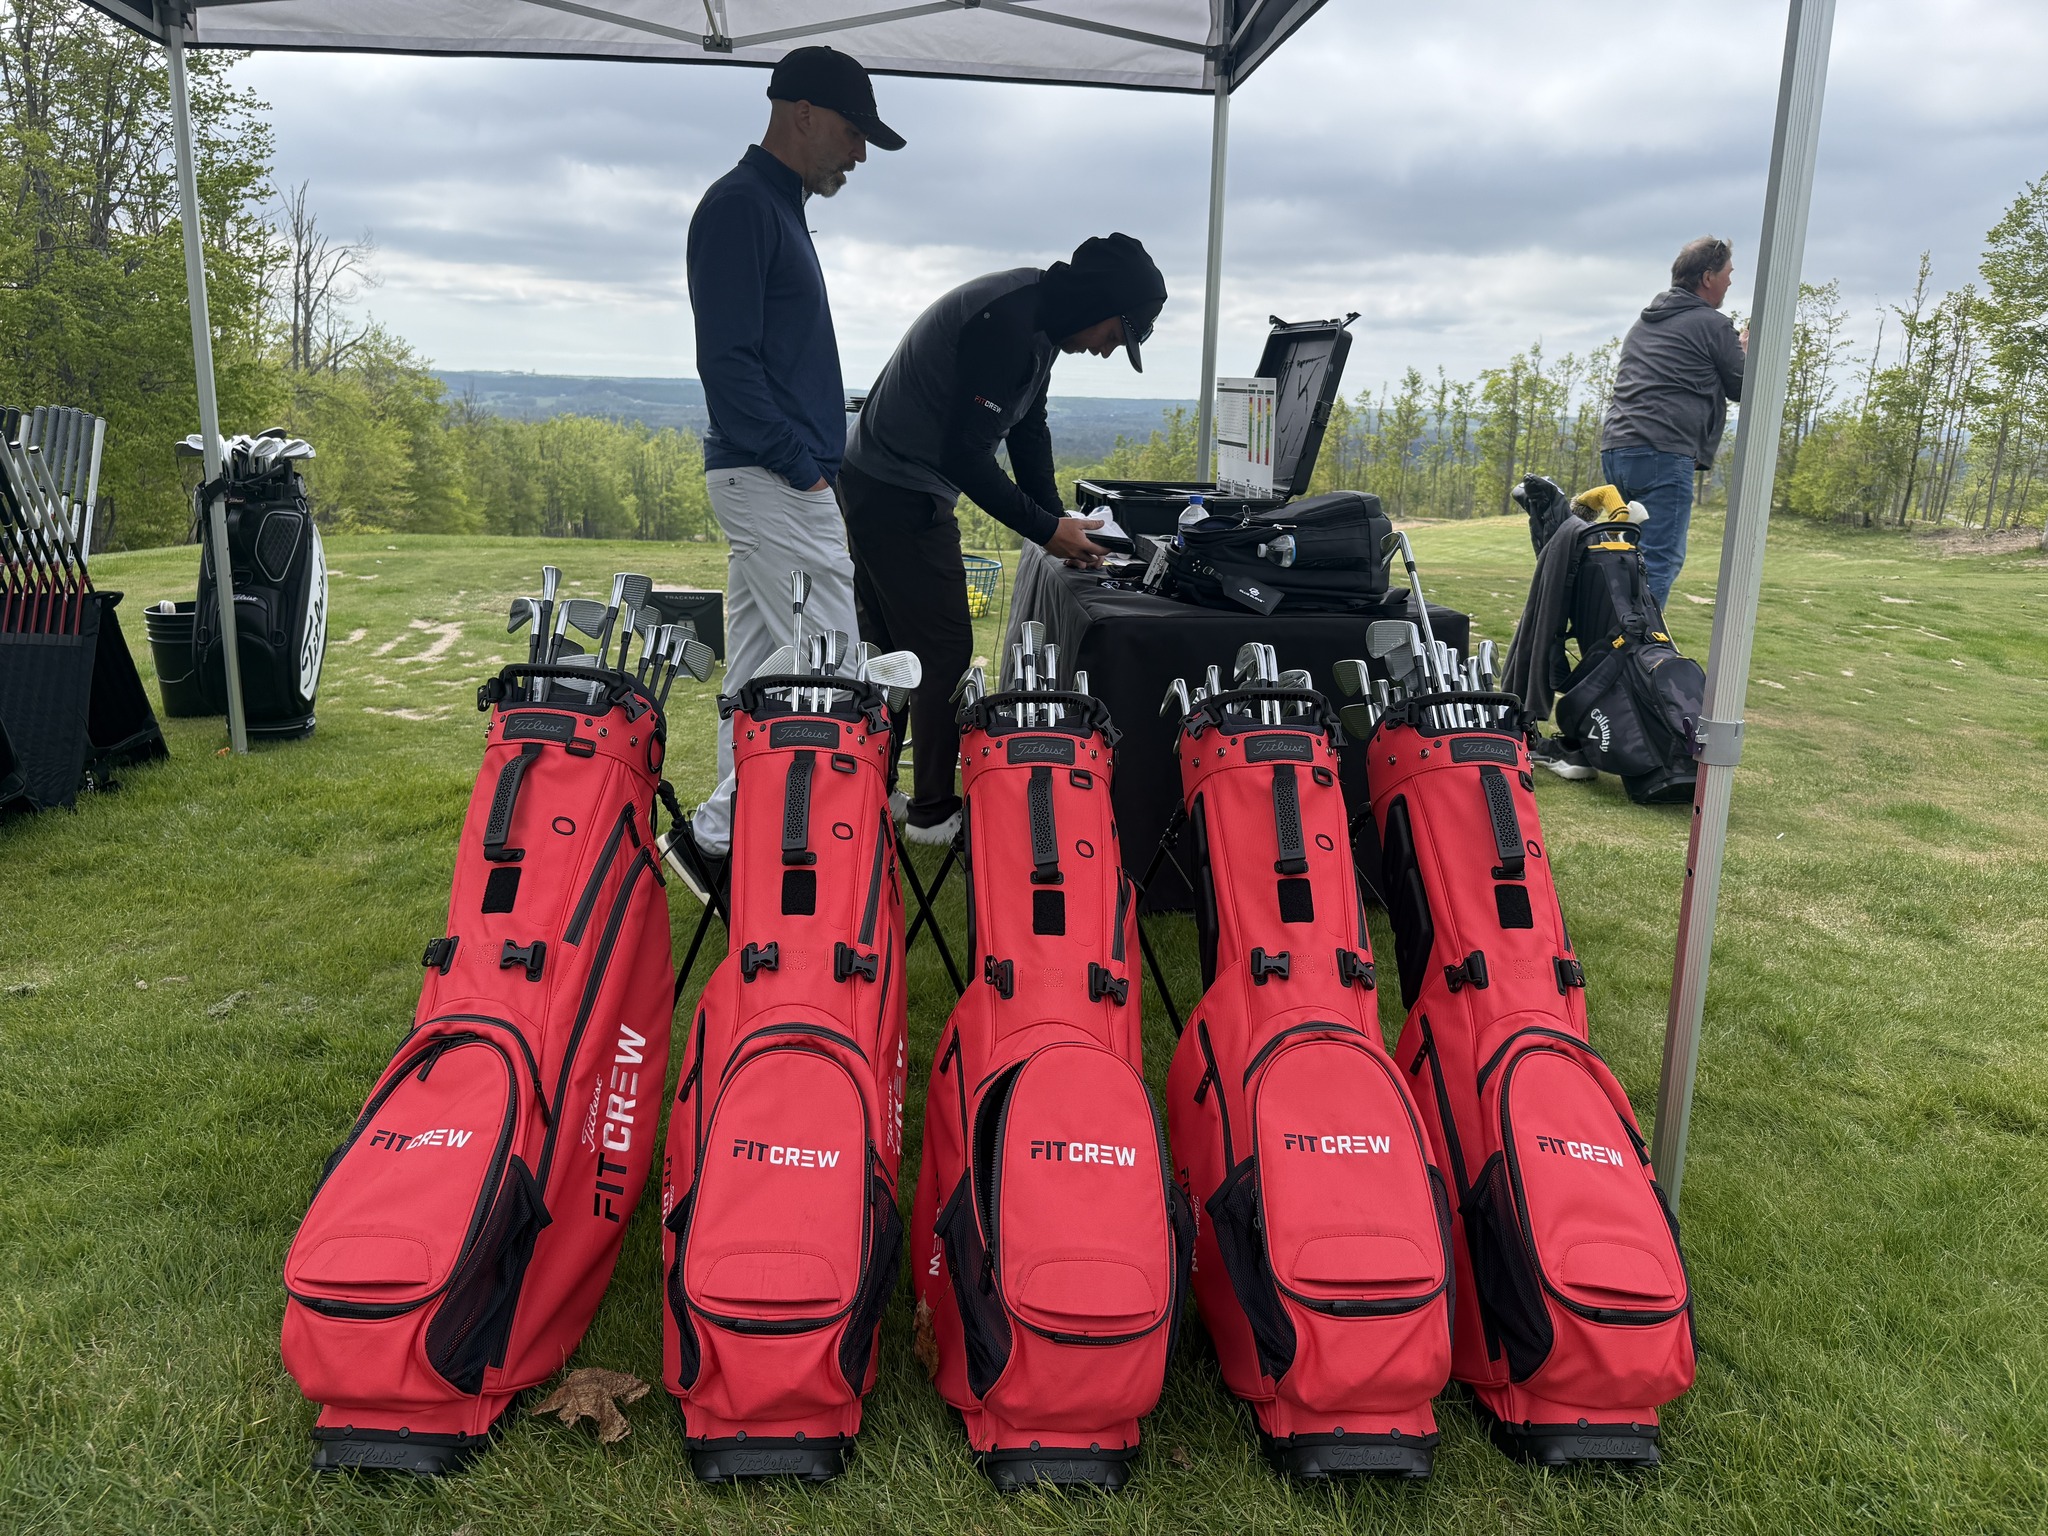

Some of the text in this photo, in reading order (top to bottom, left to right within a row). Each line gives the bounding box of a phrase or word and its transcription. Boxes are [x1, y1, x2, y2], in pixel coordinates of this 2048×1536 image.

[510, 717, 564, 733] Titleist
[776, 725, 831, 741] Titleist
[1590, 708, 1611, 752] Callaway
[1014, 741, 1068, 757] Titleist
[1253, 739, 1306, 755] Titleist
[1460, 741, 1512, 757] Titleist
[581, 1073, 603, 1153] Titleist
[337, 1441, 408, 1465] Titleist
[1327, 1444, 1402, 1469] Titleist
[1573, 1435, 1641, 1458] Titleist
[728, 1449, 804, 1474] Titleist
